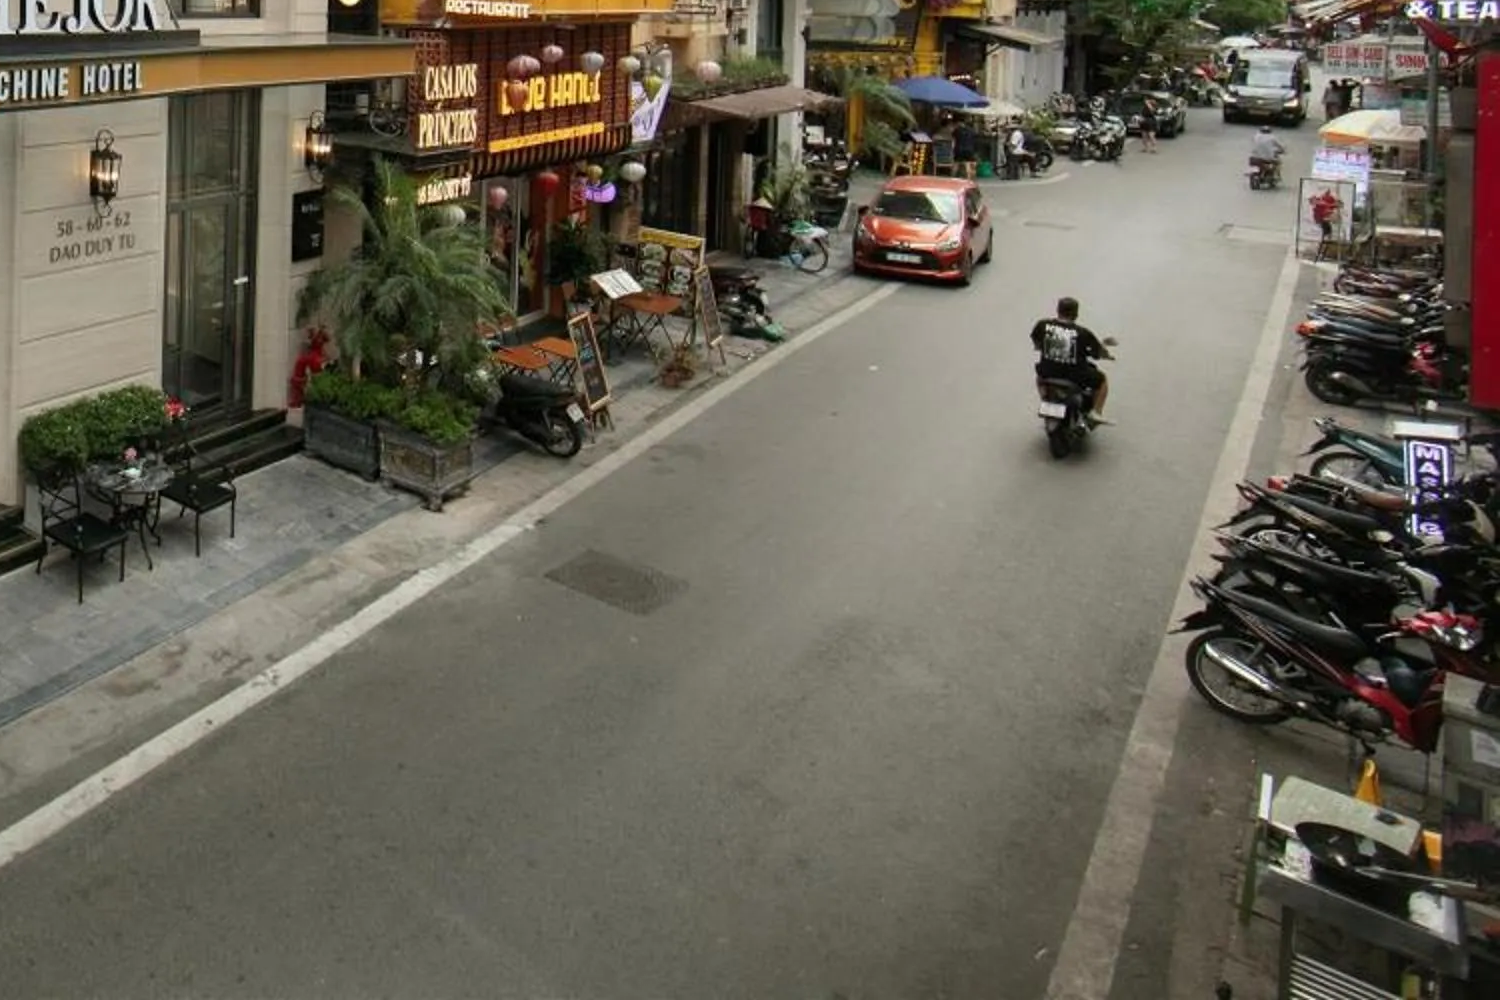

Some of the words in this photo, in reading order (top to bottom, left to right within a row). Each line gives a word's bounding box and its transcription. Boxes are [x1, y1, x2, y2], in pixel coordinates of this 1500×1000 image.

[1404, 0, 1433, 18] &
[1438, 0, 1498, 19] TEA
[83, 62, 143, 95] HOTEL
[425, 65, 453, 100] CASA
[454, 63, 477, 98] DOS
[56, 219, 73, 238] 58
[115, 211, 131, 227] 62
[85, 236, 114, 257] DUY
